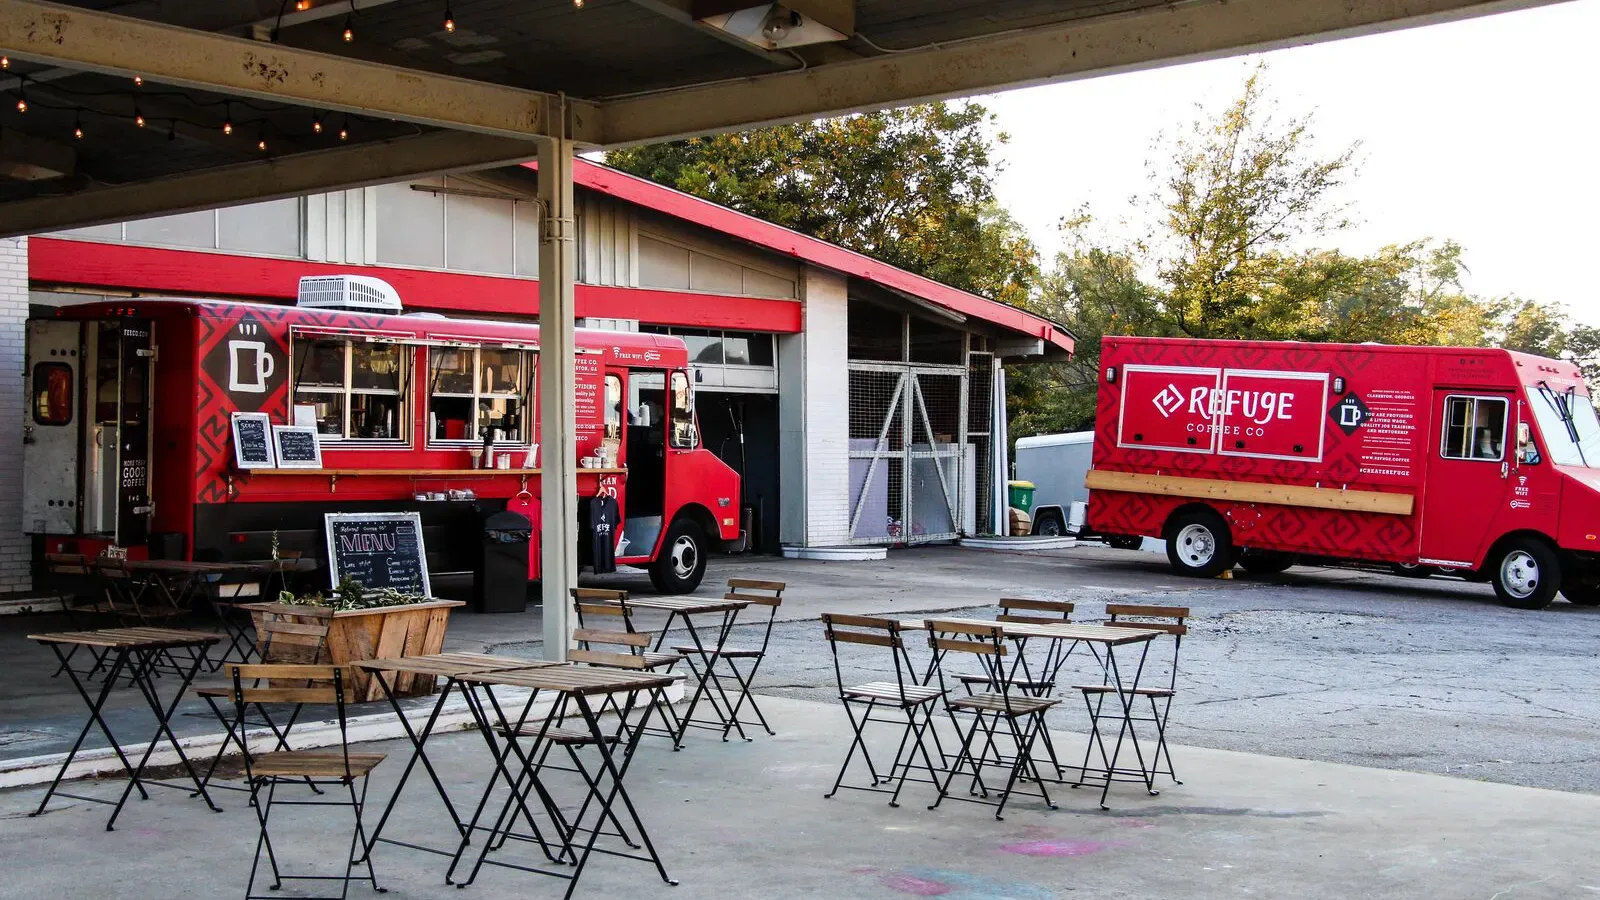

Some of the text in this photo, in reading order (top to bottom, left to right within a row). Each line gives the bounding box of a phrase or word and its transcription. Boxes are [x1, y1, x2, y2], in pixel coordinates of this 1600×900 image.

[1186, 423, 1264, 437] COFFEE CO
[123, 466, 146, 478] GOOD
[1359, 468, 1410, 476] #CREATEREFUGE
[122, 478, 146, 488] COFFEE
[340, 533, 396, 552] MENU
